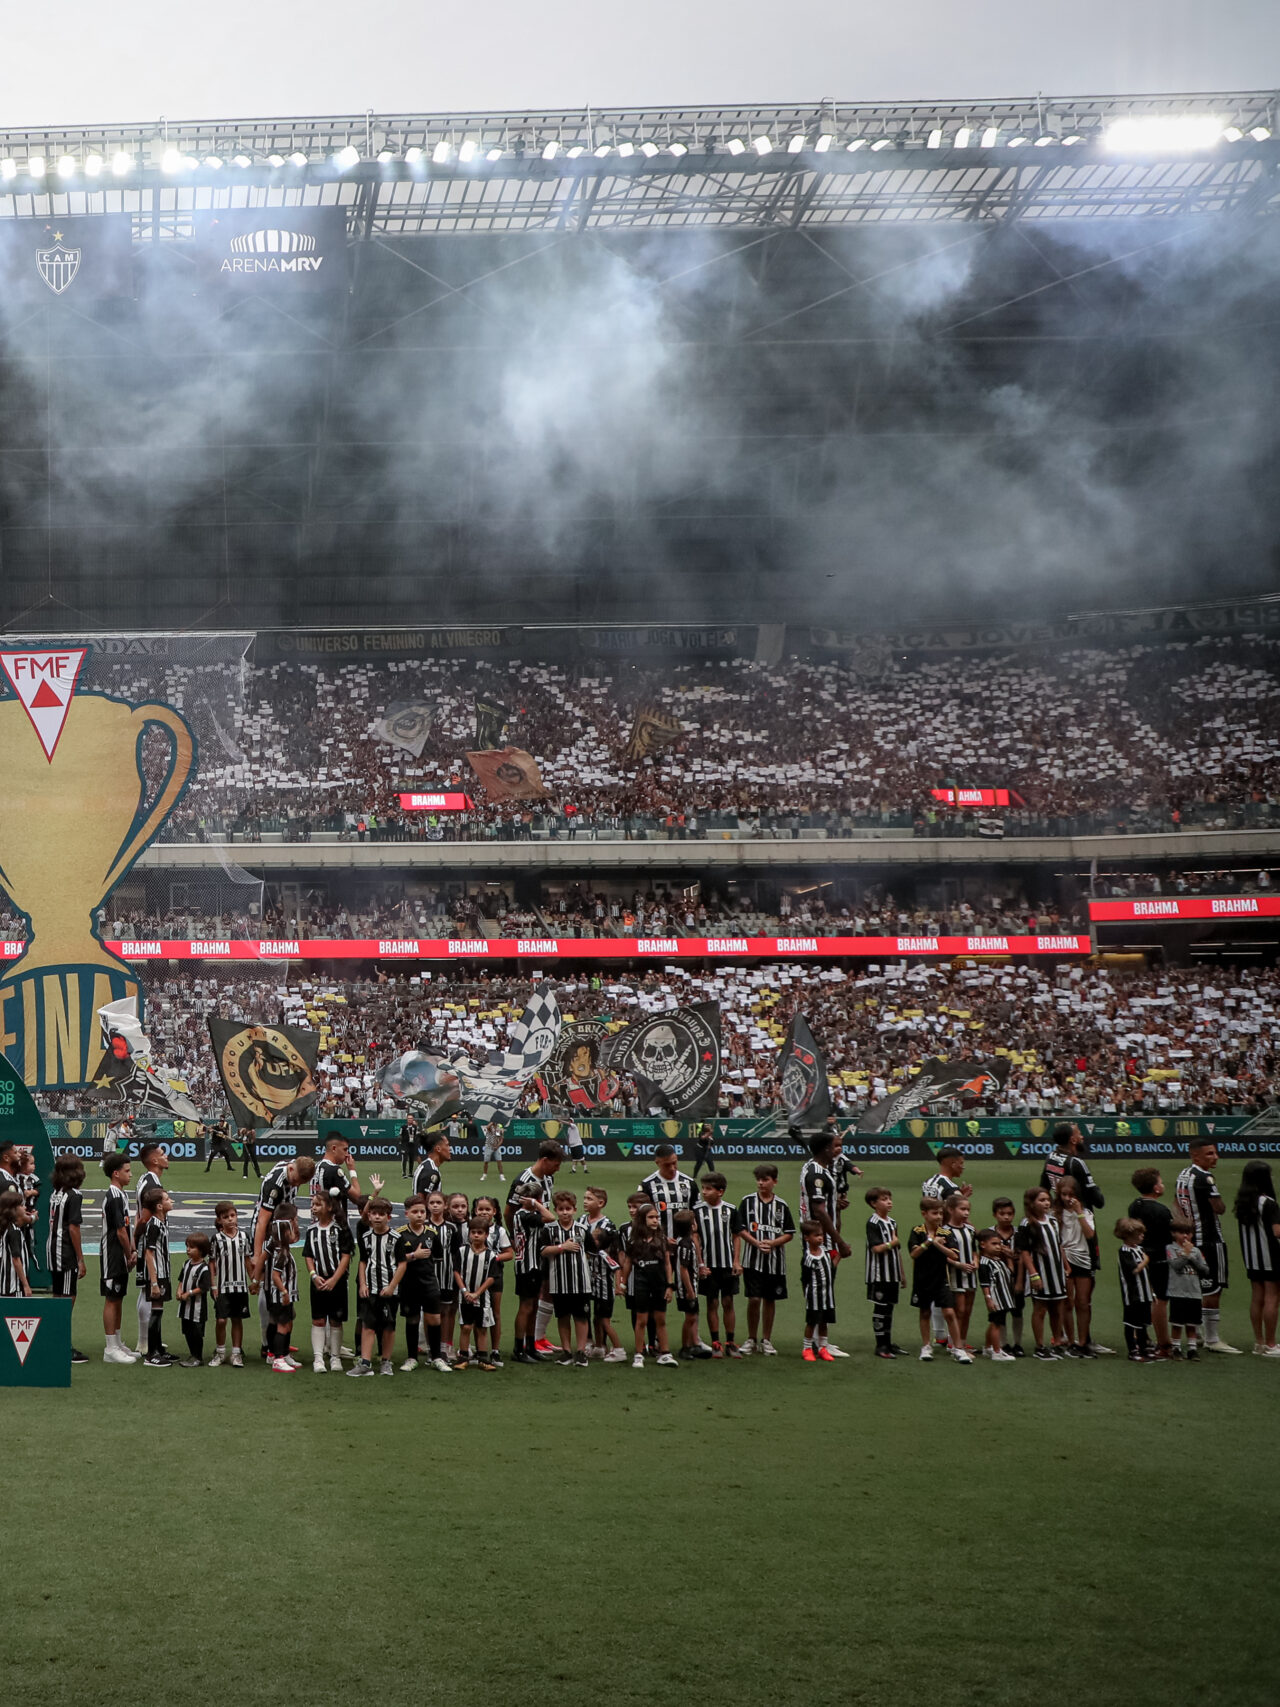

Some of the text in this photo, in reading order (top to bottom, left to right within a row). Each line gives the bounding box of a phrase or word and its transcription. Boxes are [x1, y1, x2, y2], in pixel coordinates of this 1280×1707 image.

[42, 252, 75, 262] CAM
[296, 630, 501, 652] UNIVERSO FEMININO ALVINEGRO
[14, 655, 70, 681] FMF
[411, 795, 446, 806] BRAHMA
[948, 791, 983, 802] BAHMA
[1134, 902, 1179, 914] BRAHMA
[1212, 900, 1258, 912] BRAHMA
[122, 943, 161, 954] BRAHMA
[191, 942, 230, 954] BRAHMA
[260, 942, 299, 954] BRAHMA
[379, 941, 419, 953] BRAHMA
[449, 941, 488, 953] BRAHMA
[518, 941, 557, 952] BRAHMA
[638, 940, 678, 952] BRAHMA
[708, 940, 748, 951] BRAHMA
[777, 939, 817, 951] BRAHMA
[898, 938, 938, 950] BRAHMA
[968, 938, 1008, 949] BRAHMA
[1038, 937, 1078, 949] BRAHMA
[256, 1145, 297, 1156] ICOOB
[360, 1146, 400, 1157] BANCO,
[450, 1146, 470, 1155] ARA
[471, 1146, 479, 1155] O
[727, 1145, 745, 1155] DO
[747, 1145, 787, 1156] BANCO,
[860, 1145, 869, 1154] O
[870, 1144, 910, 1154] SICOOB
[1090, 1143, 1114, 1153] SAIA
[1116, 1143, 1133, 1153] DO
[1135, 1143, 1176, 1154] BANCO,
[1217, 1142, 1248, 1152] PARA
[1248, 1143, 1257, 1152] O
[10, 1319, 35, 1330] FMF
